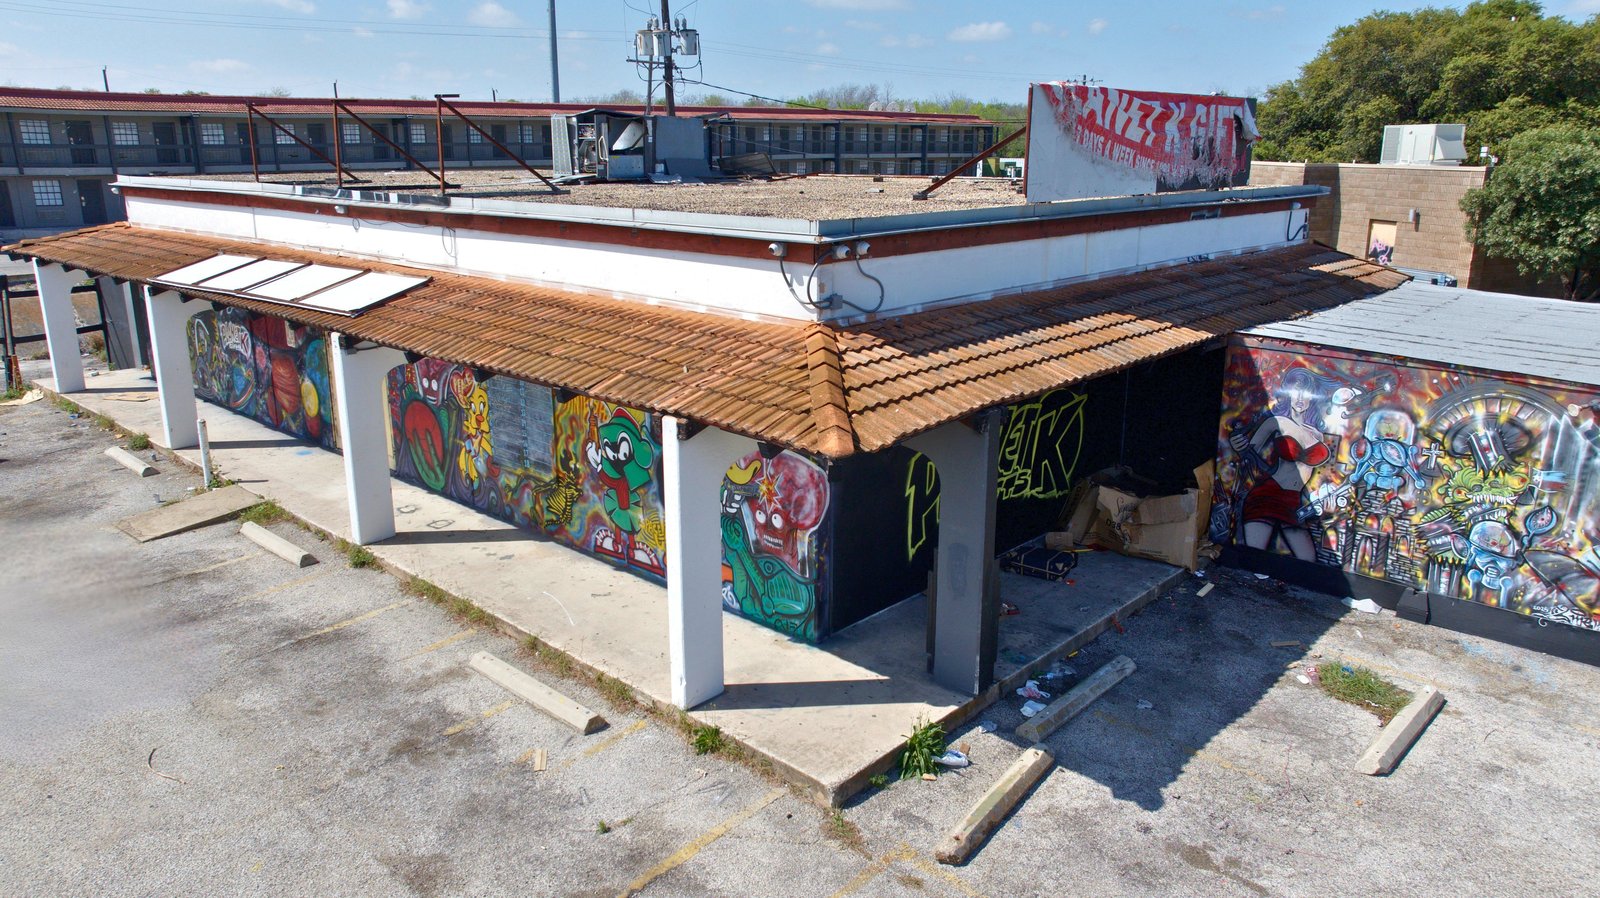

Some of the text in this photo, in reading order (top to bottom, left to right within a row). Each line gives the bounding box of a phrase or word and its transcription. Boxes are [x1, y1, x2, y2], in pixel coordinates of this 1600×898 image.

[1082, 129, 1105, 153] DAYS
[1104, 139, 1112, 160] A
[1112, 142, 1136, 168] WEEK
